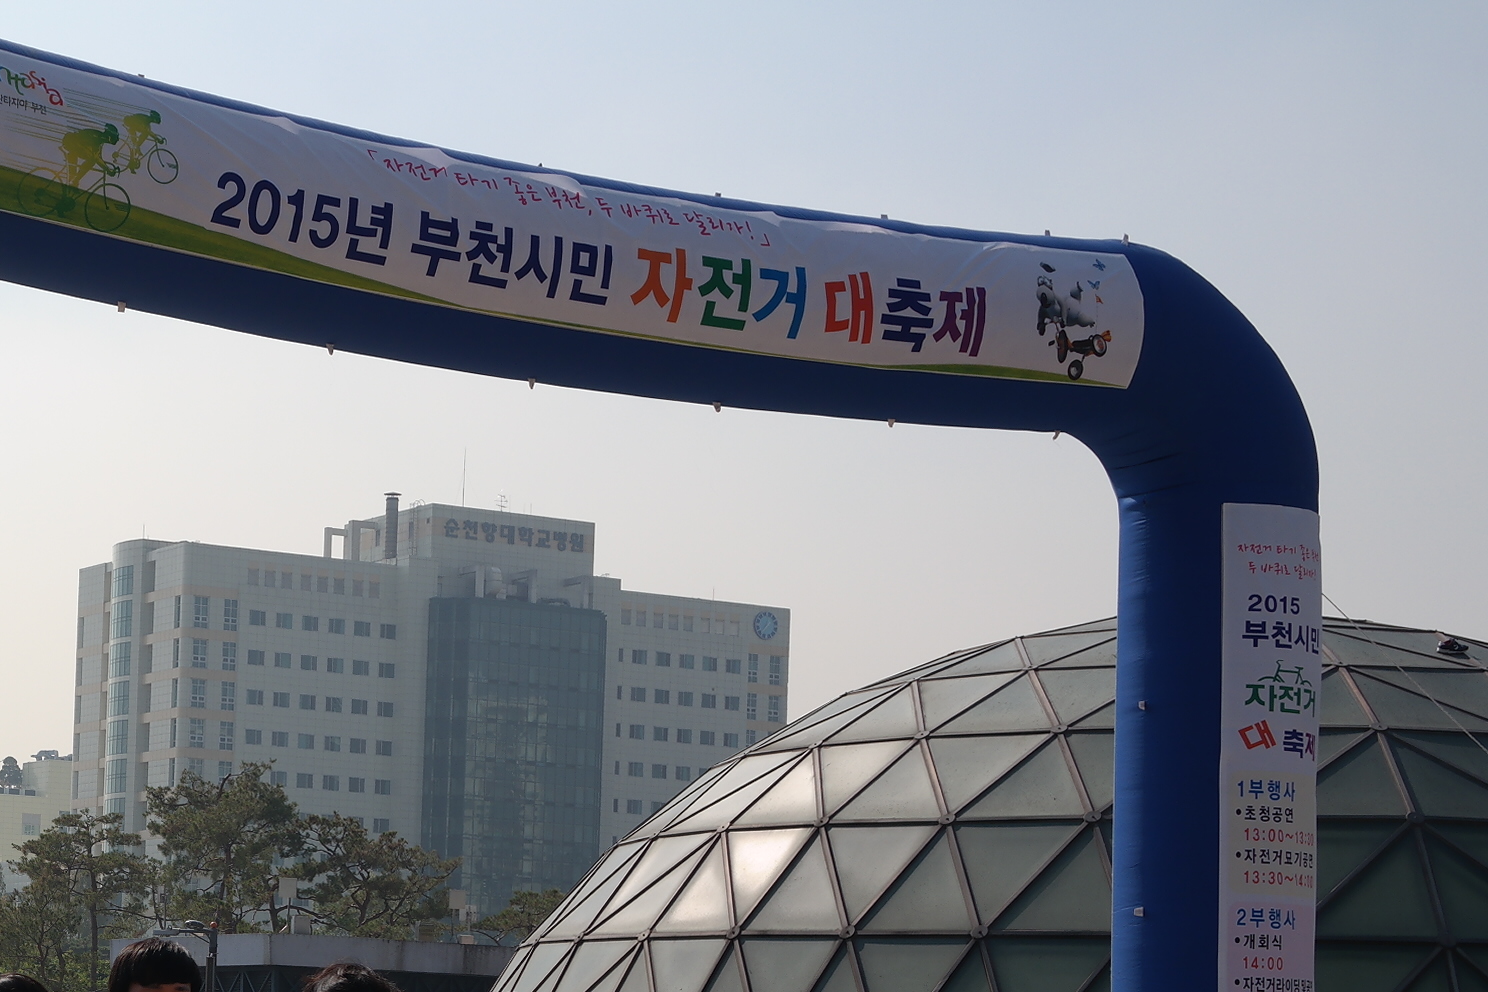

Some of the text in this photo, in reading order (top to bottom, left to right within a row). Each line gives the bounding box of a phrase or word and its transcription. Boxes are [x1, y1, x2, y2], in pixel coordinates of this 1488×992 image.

[454, 172, 498, 190] 타기
[503, 177, 542, 206] 좋은
[545, 187, 592, 216] 부천,
[595, 197, 612, 218] 두
[620, 204, 679, 226] 바퀴로
[210, 171, 393, 266] 2015년
[410, 209, 613, 307] 부천시민
[629, 247, 807, 340] 자전거
[444, 518, 584, 553] 순천향대학교병원
[1237, 543, 1272, 555] 자전거
[1276, 545, 1297, 555] 타기
[1248, 561, 1257, 574] 두
[1261, 562, 1291, 576] 바퀴로
[1248, 594, 1300, 615] 2015
[1242, 620, 1319, 656] 부천시민
[1244, 684, 1315, 718] 자전거
[1244, 806, 1294, 824] 초청공연
[1243, 934, 1283, 951] 개회식
[1242, 956, 1284, 972] 14:00
